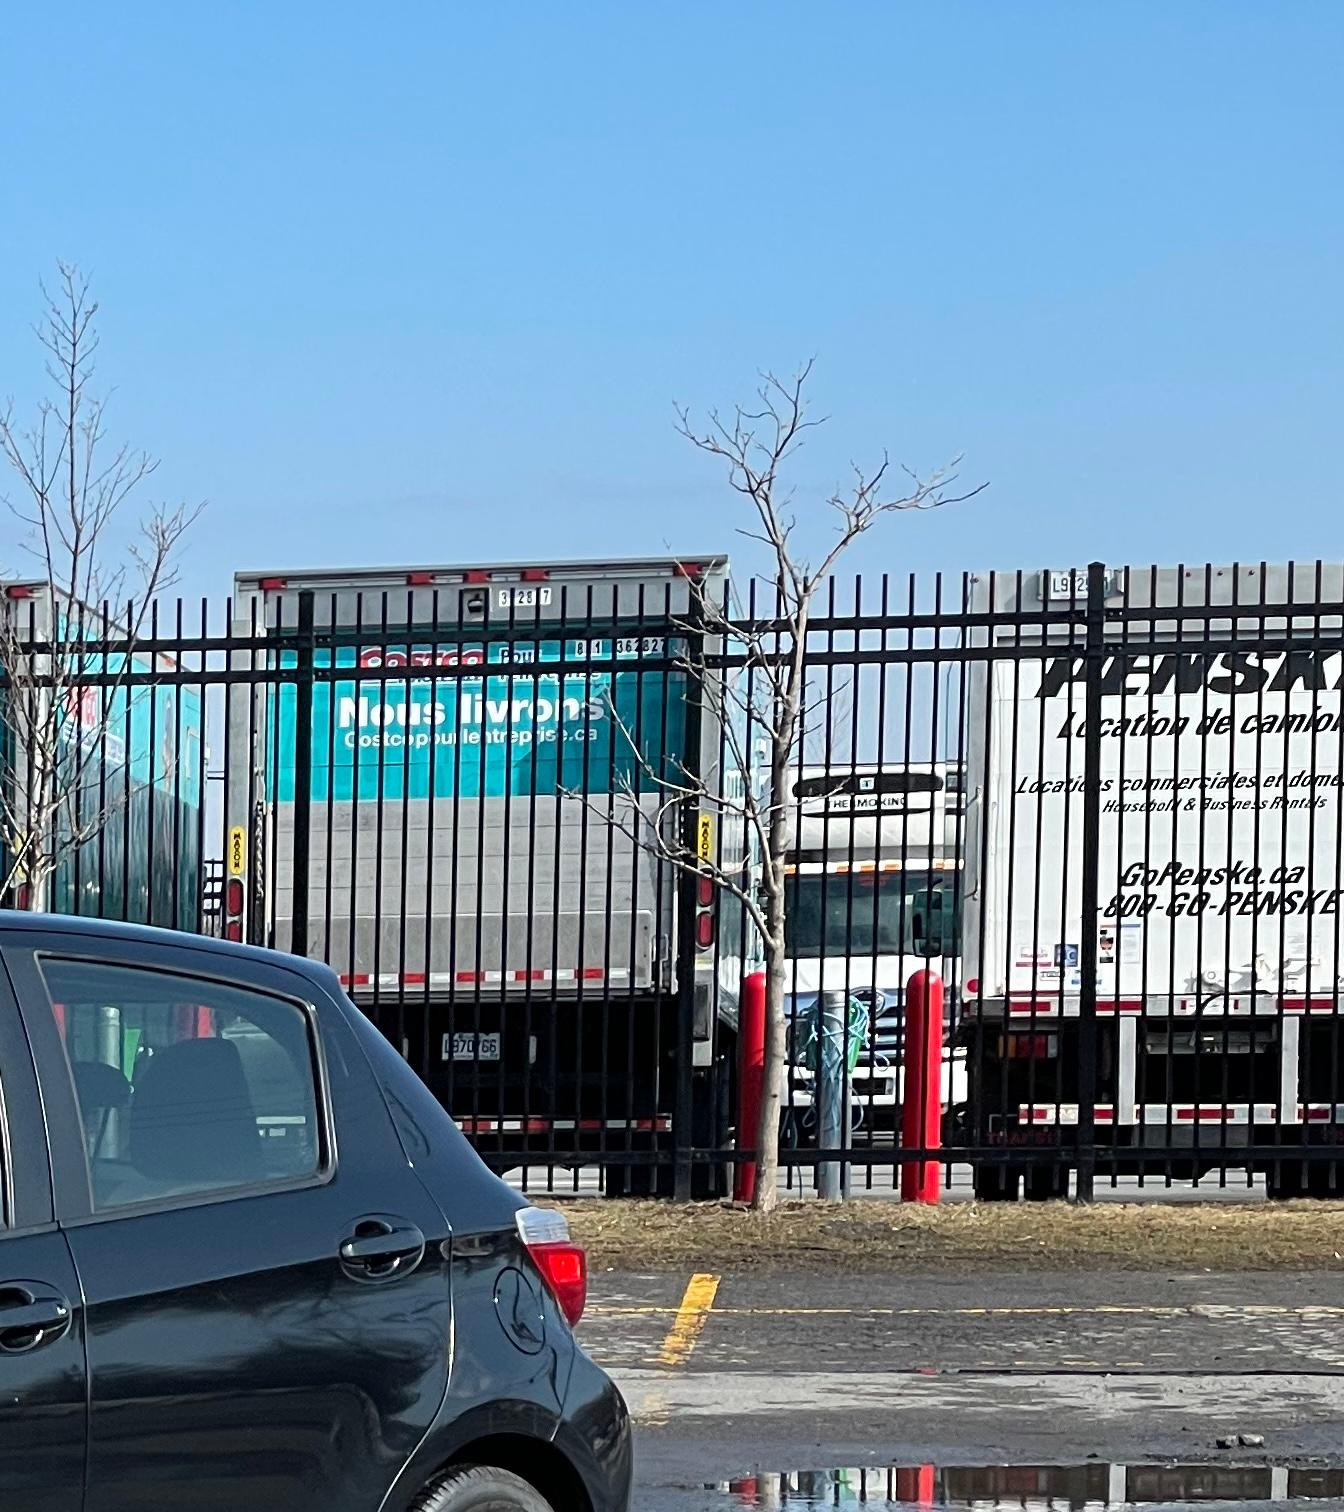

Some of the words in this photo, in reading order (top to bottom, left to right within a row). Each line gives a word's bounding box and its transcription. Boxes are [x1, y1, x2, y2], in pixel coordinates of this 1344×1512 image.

[501, 590, 549, 605] 3287
[577, 641, 601, 655] 81
[1034, 652, 1344, 698] PENSK
[339, 696, 446, 728] Nous
[460, 693, 605, 724] livrons
[1056, 707, 1190, 739] Location
[1195, 707, 1232, 736] de
[1015, 775, 1115, 795] Locatios
[1263, 773, 1286, 788] et
[1288, 769, 1344, 788] dome
[1183, 797, 1197, 812] &
[1119, 860, 1306, 887] GoPenske.ca
